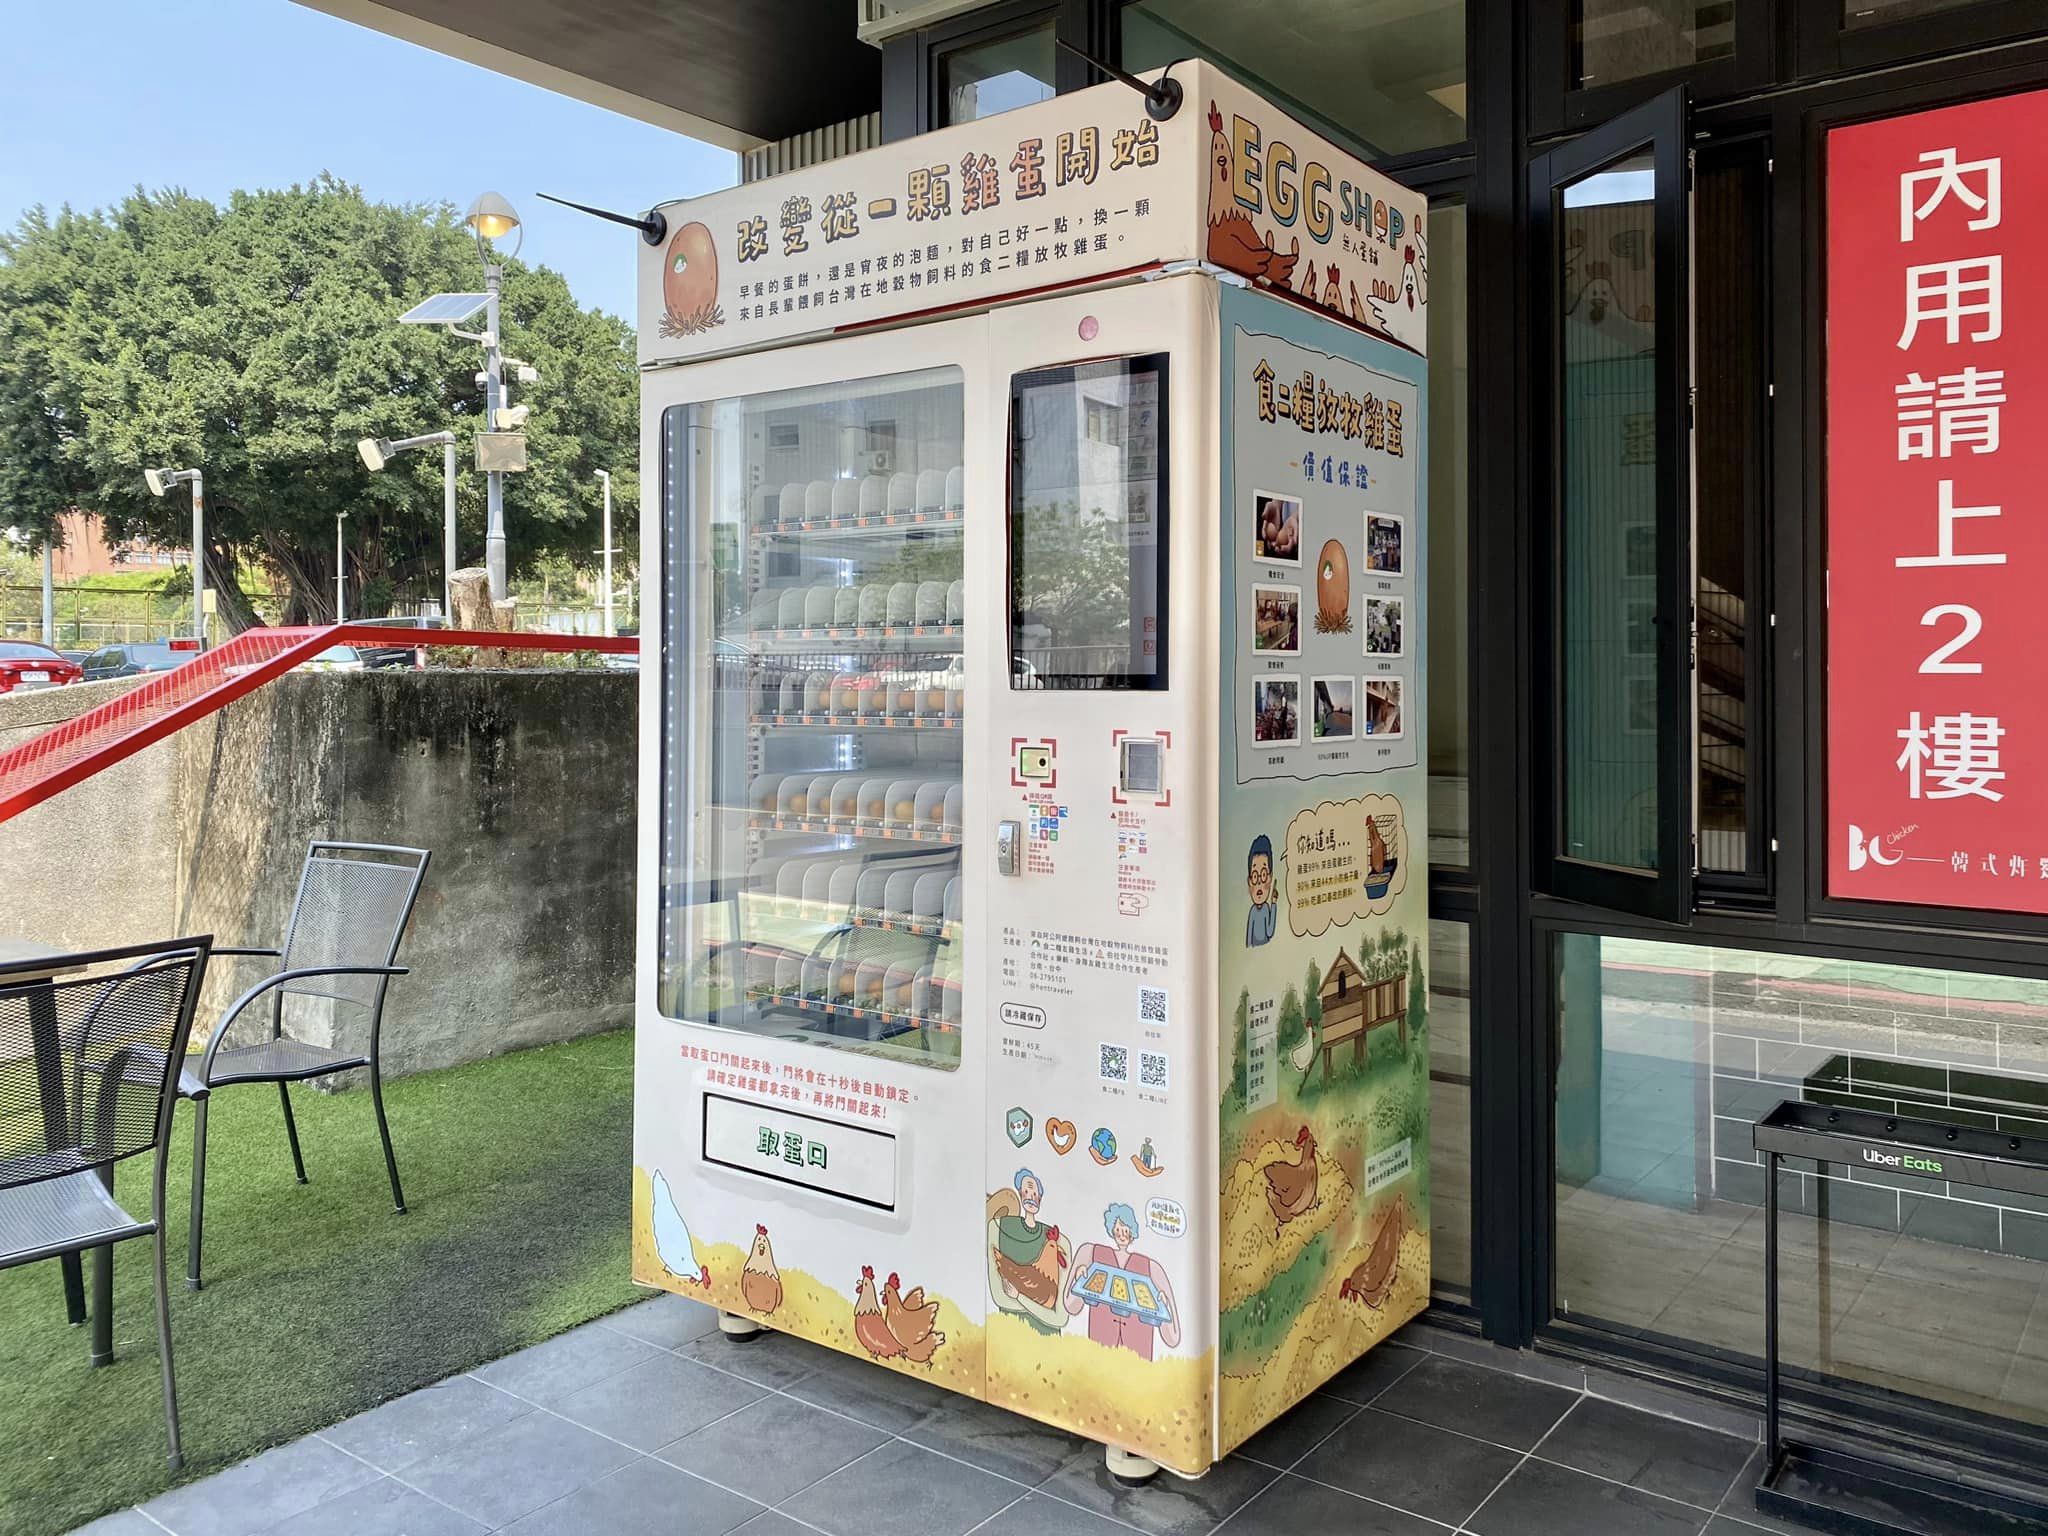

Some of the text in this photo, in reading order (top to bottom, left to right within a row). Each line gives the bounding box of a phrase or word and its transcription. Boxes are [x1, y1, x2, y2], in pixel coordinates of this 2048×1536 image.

[736, 118, 1160, 263] 改變從一顆雞蛋開始
[1233, 113, 1405, 251] EGG SHOP
[1253, 358, 1404, 458] 食二糧放牧雞蛋
[1894, 147, 2007, 802] 內用請上2樓
[1886, 823, 1920, 845] Chicken
[756, 1125, 828, 1170] 取蛋口
[1862, 1148, 1943, 1174] Uber Eats
